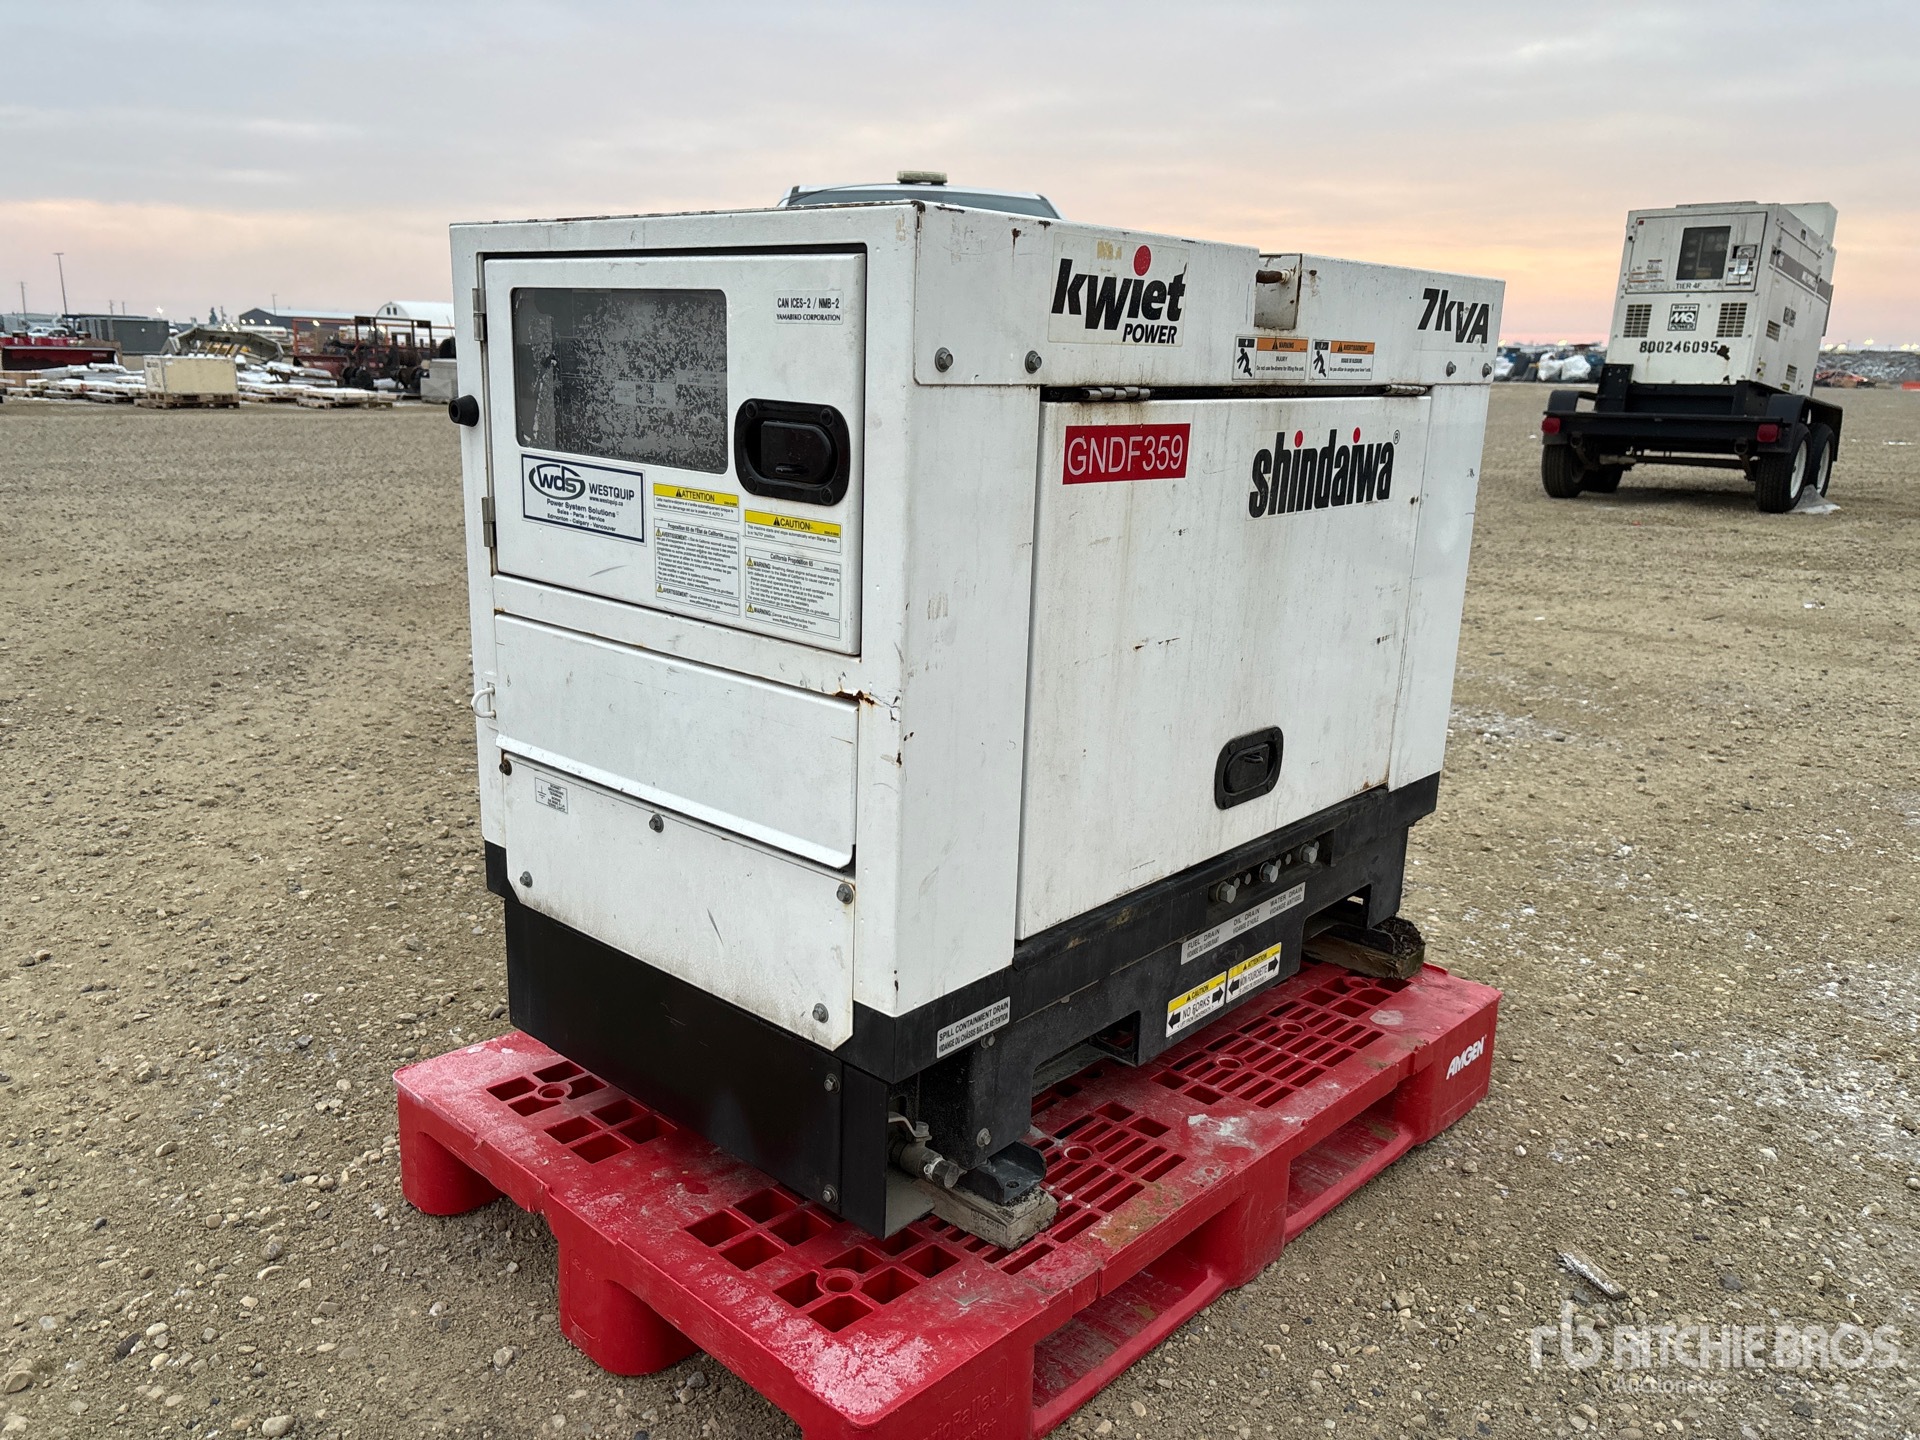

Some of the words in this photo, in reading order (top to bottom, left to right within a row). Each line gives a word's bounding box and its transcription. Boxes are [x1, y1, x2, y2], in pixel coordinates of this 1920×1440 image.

[1051, 245, 1186, 330] kwiet
[777, 297, 789, 309] CAN
[790, 297, 811, 309] ICES-2
[818, 297, 840, 309] NMB-2
[776, 313, 802, 321] YAMABIKO
[1417, 288, 1489, 344] 7kVA
[1671, 312, 1695, 323] MQ
[1122, 323, 1178, 344] POWER
[1640, 341, 1719, 353] 800246095
[1067, 435, 1183, 476] GNDF359
[1249, 427, 1395, 518] shindaiwa
[588, 482, 635, 500] WESTQUIP
[682, 490, 715, 502] ATTENTION
[546, 498, 564, 508] Power
[565, 502, 587, 513] System
[588, 506, 616, 518] Solutions
[573, 511, 585, 519] Parts
[547, 513, 569, 522] Edmonton
[573, 518, 590, 527] Calgary
[593, 522, 617, 532] Vancouver
[780, 518, 810, 531] CAUTION
[770, 553, 787, 562] California
[1270, 894, 1286, 907] WATER
[1288, 886, 1303, 898] DRAIN
[1233, 917, 1241, 926] OIL
[1244, 908, 1260, 920] DRAIN
[1187, 940, 1200, 950] FUEL
[1203, 929, 1220, 942] DRAIN
[1247, 953, 1267, 968] ATTENTION
[1191, 984, 1209, 999] CAUTION
[1182, 1006, 1191, 1019] NO
[1192, 996, 1210, 1013] FORKS
[939, 1028, 954, 1041] SPILL
[954, 1009, 992, 1034] CONTAINMENT
[992, 1001, 1009, 1015] DRAIN
[954, 1036, 960, 1045] DU
[976, 1024, 984, 1034] BAC
[983, 1021, 989, 1030] DE
[1446, 1036, 1485, 1080] AMGEN
